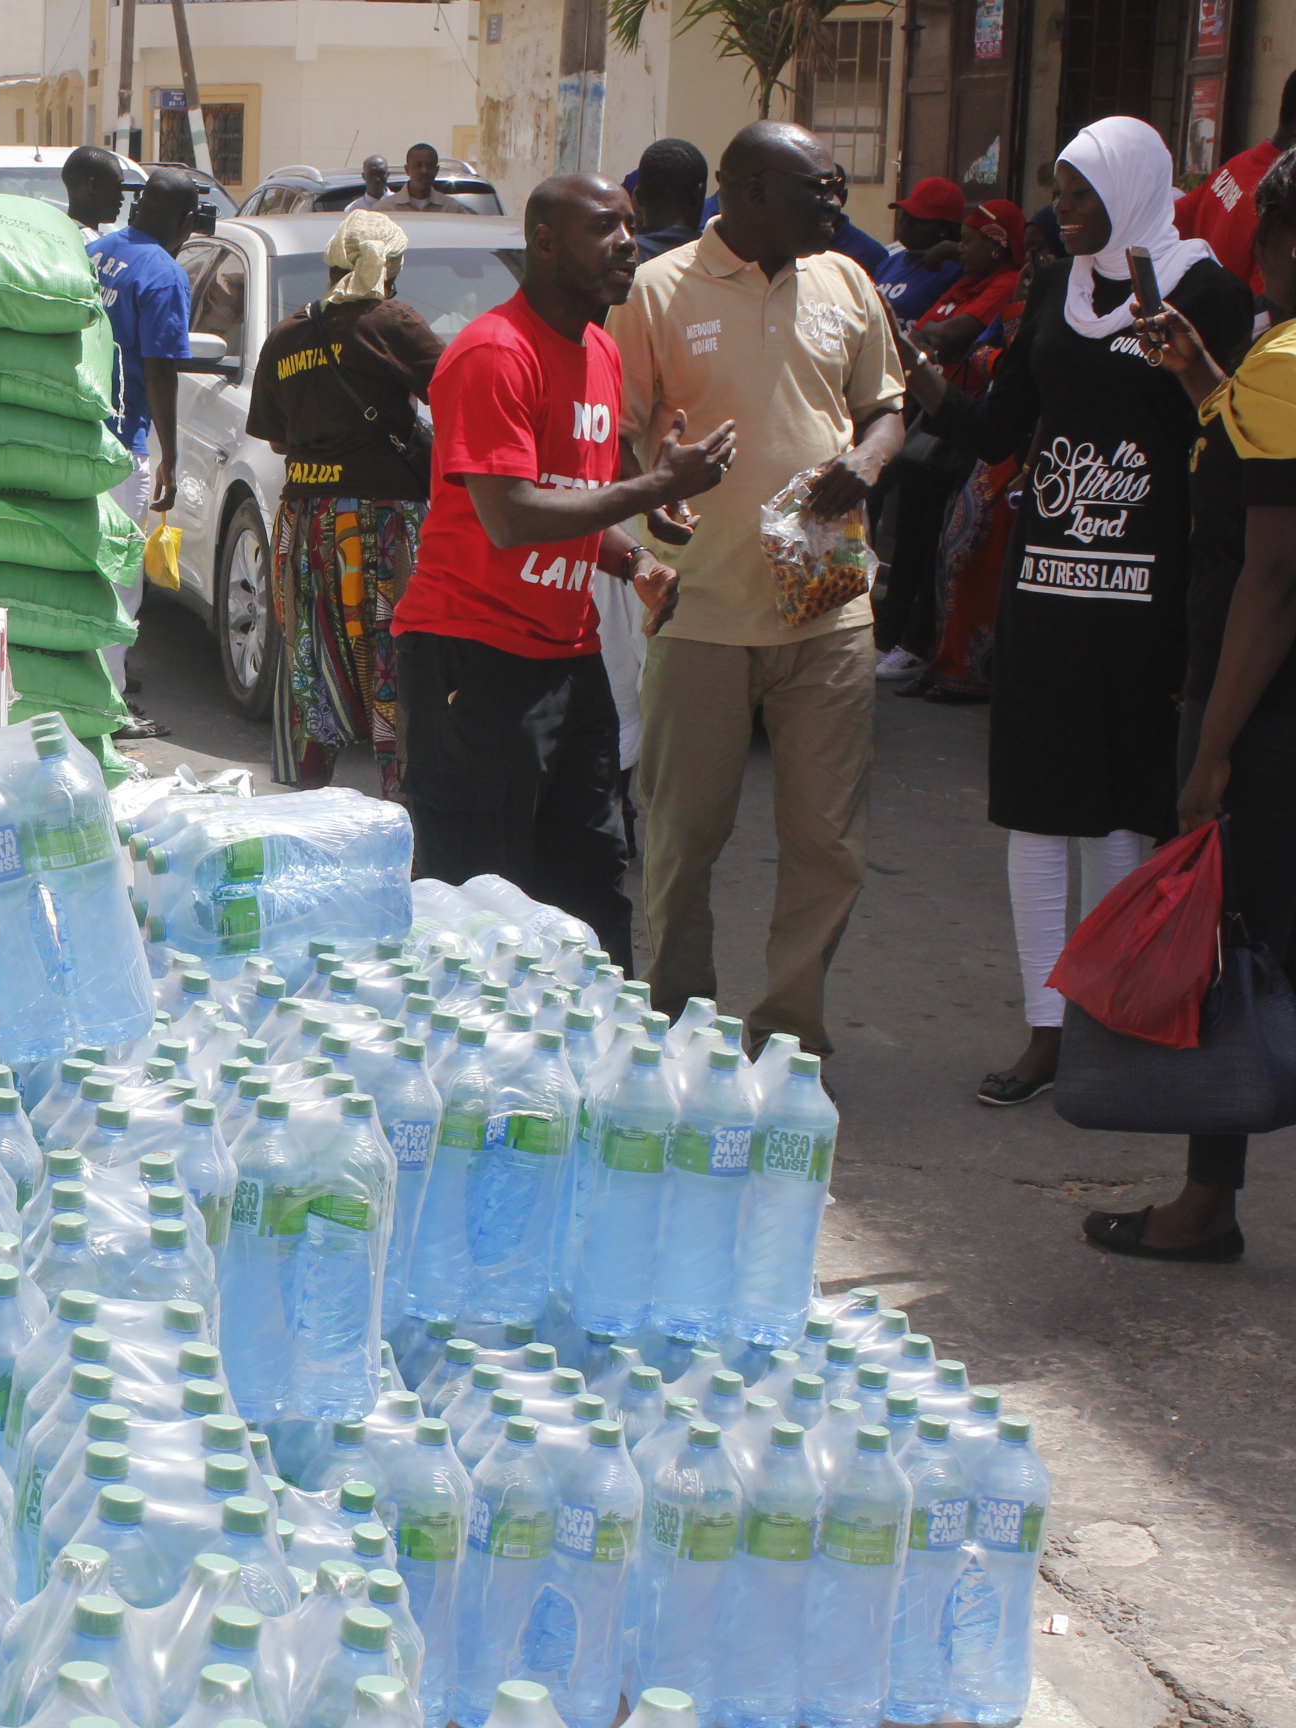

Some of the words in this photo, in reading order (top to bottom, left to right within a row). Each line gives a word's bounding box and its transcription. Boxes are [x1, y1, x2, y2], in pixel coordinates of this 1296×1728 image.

[572, 400, 611, 443] NO
[1112, 440, 1147, 468] No
[1032, 436, 1151, 518] Stress
[1064, 505, 1128, 544] Land
[1038, 560, 1098, 588] STRESS
[1100, 565, 1150, 592] LAND
[392, 1121, 432, 1137] CASA
[714, 1130, 752, 1143] CASA
[392, 1135, 430, 1150] MAN
[768, 1130, 810, 1147] CASA
[714, 1142, 750, 1156] MAN
[766, 1142, 810, 1160] MAN
[976, 1499, 1020, 1517] CASA
[976, 1512, 1020, 1530] MAN
